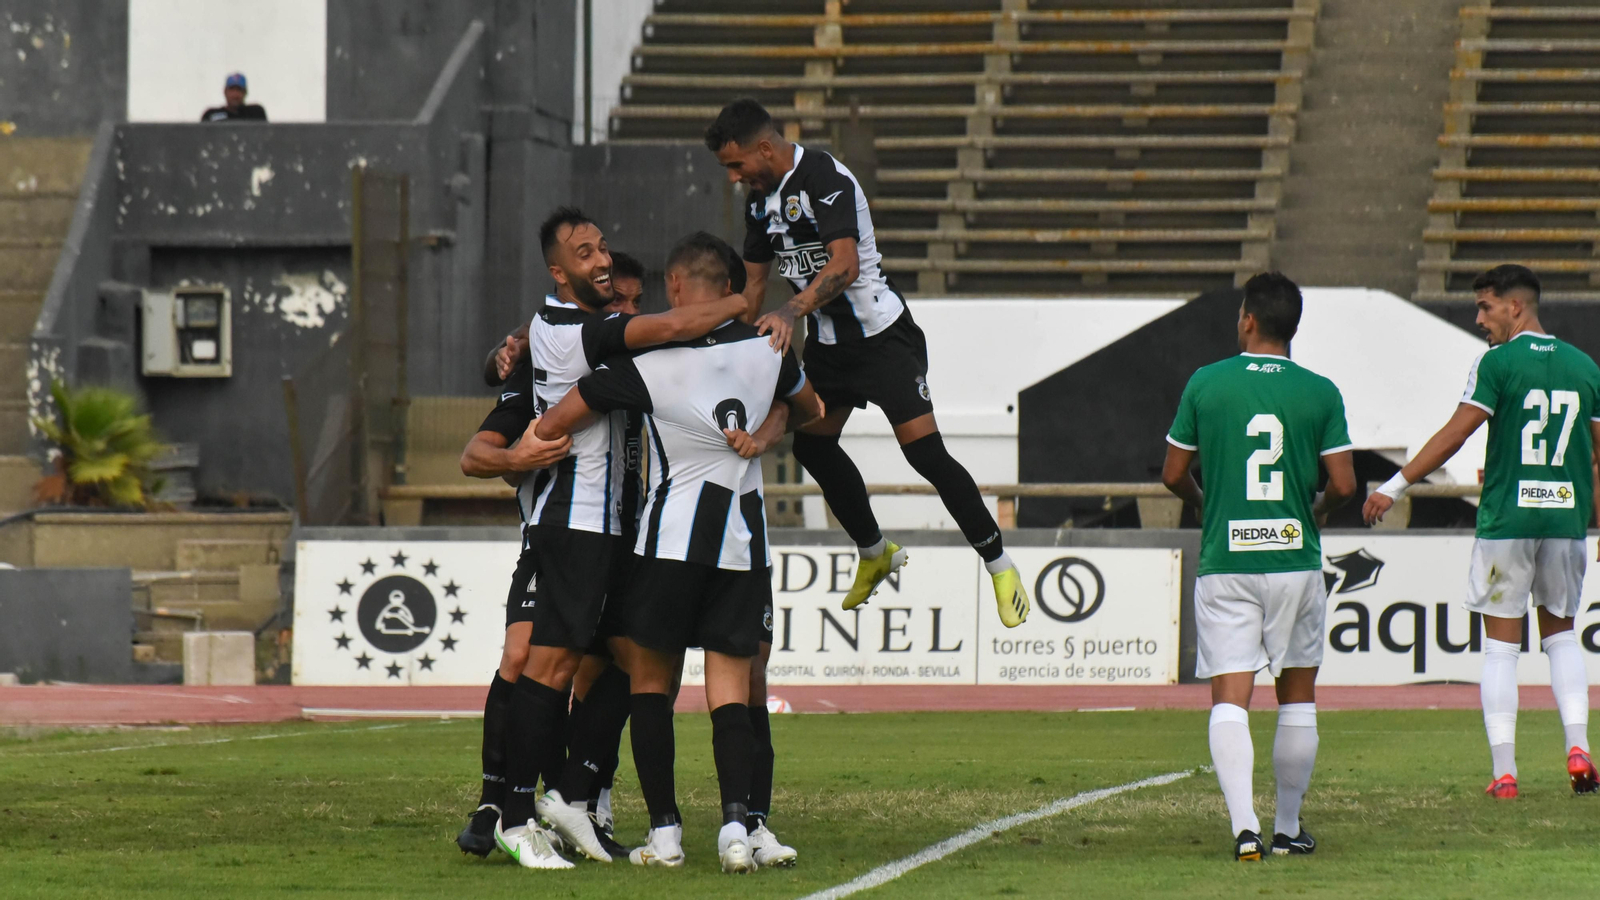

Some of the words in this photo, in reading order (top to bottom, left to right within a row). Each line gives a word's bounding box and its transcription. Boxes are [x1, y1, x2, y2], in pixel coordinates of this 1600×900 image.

[1521, 388, 1580, 467] 27
[1246, 413, 1284, 501] 2
[992, 637, 1055, 655] torres
[1083, 637, 1157, 659] puerto
[873, 666, 910, 677] RONDA
[918, 666, 960, 677] SEVILLA
[999, 663, 1060, 681] agencia
[1065, 663, 1084, 678] de
[1089, 666, 1151, 681] seguros
